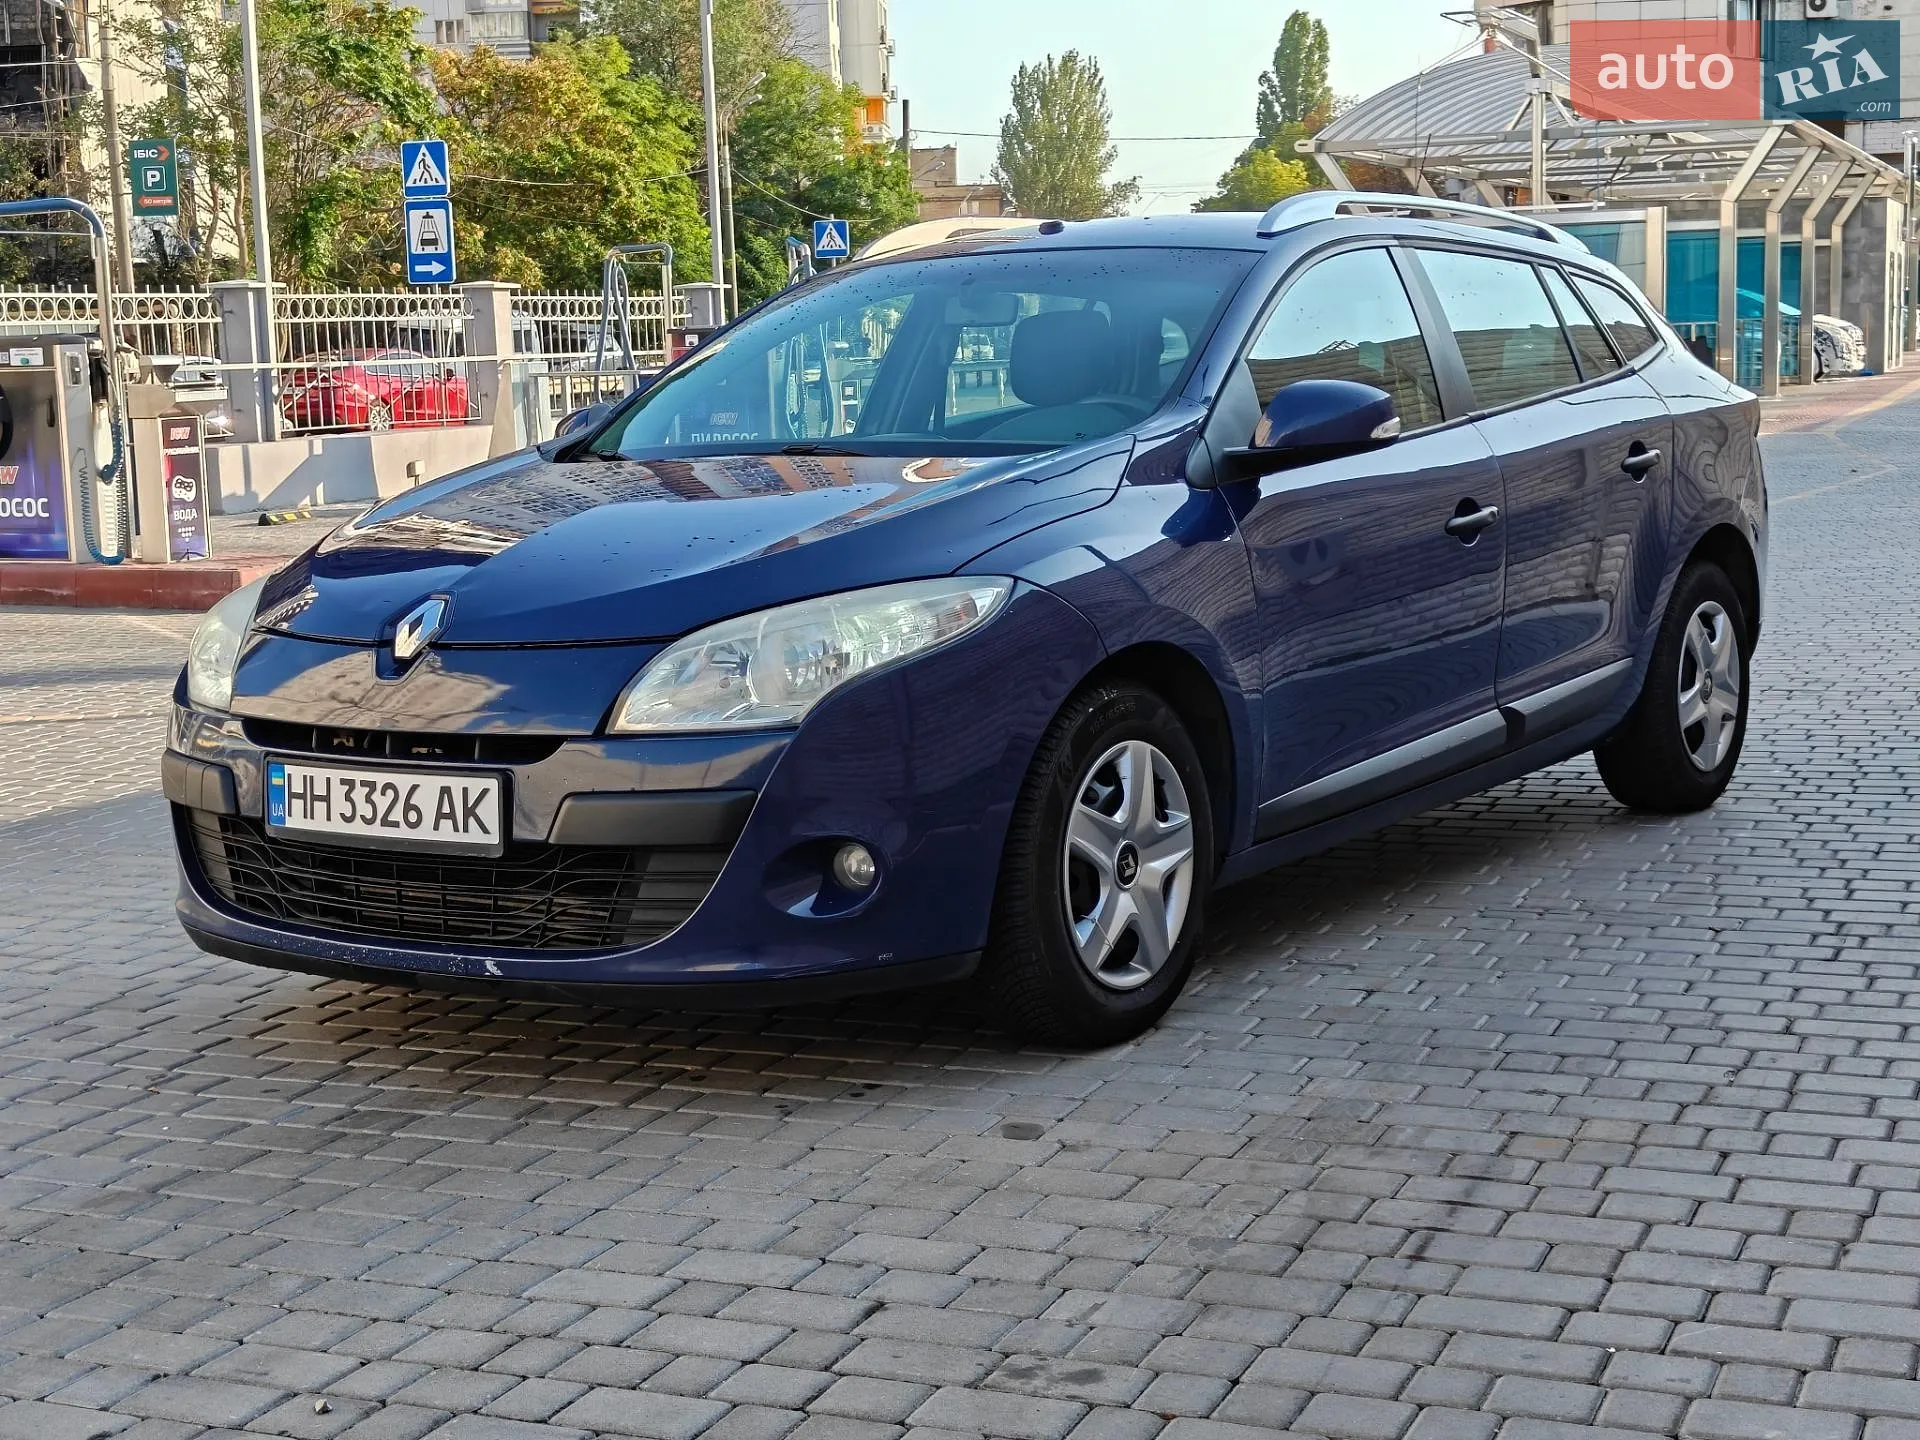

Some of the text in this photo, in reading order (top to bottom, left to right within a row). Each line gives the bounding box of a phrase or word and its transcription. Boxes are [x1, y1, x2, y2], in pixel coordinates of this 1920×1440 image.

[146, 170, 161, 187] P
[173, 508, 198, 521] ВОДА
[272, 803, 285, 817] UA
[287, 773, 492, 835] HH 3326 AK
